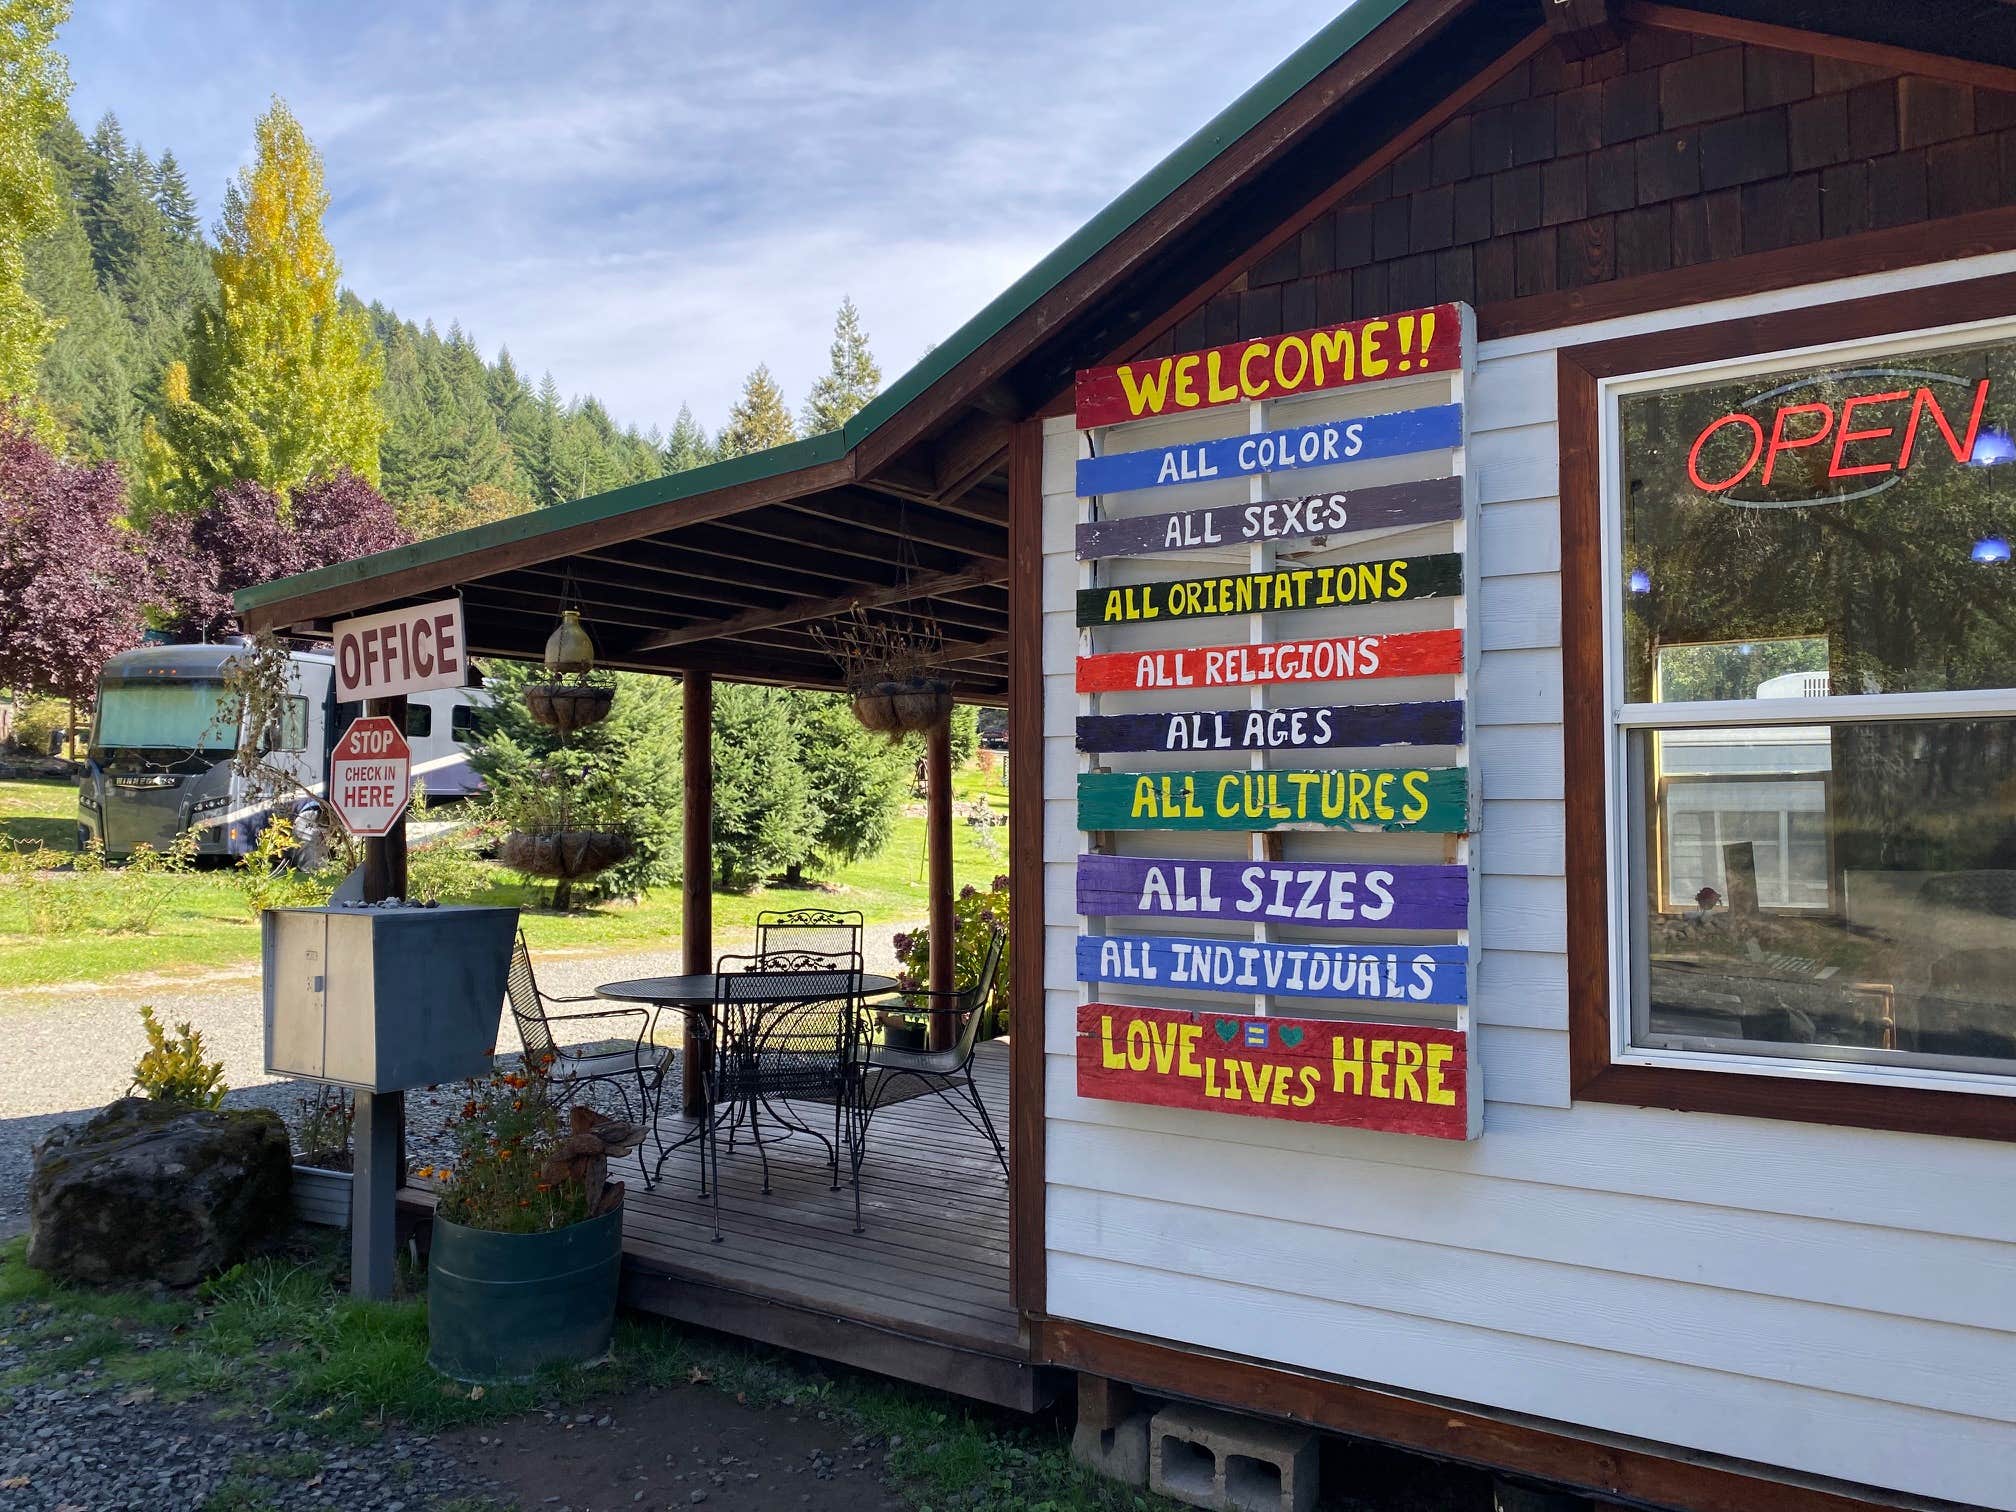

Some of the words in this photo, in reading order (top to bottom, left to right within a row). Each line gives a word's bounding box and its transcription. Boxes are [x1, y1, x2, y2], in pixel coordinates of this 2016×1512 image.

[1117, 313, 1436, 415] WELCOME!!
[1157, 452, 1218, 484] ALL
[1239, 424, 1364, 468] COLORS
[1688, 379, 1990, 492] OPEN
[1165, 512, 1222, 548] ALL
[1242, 494, 1348, 538] SEXES
[1104, 589, 1159, 622] ALL
[1168, 561, 1409, 615] ORIENTATIONS
[339, 613, 458, 690] OFFICE
[1136, 655, 1193, 688] ALL
[1205, 638, 1380, 684] RELIGIONS
[350, 730, 394, 755] STOP
[1166, 715, 1231, 749] ALL
[1243, 709, 1332, 746] AGES
[344, 785, 395, 808] HERE
[345, 766, 382, 782] CHECK
[384, 765, 396, 781] IN
[1131, 775, 1204, 818] ALL
[1216, 771, 1429, 821] CULTURES
[1138, 866, 1222, 912] ALL
[1236, 866, 1395, 921] SIZES
[1101, 940, 1157, 979] ALL
[1170, 943, 1437, 1000] INDIVIDUALS
[1101, 1015, 1204, 1078] LOVE
[1205, 1057, 1321, 1107] LIVES
[1333, 1036, 1456, 1106] HERE
